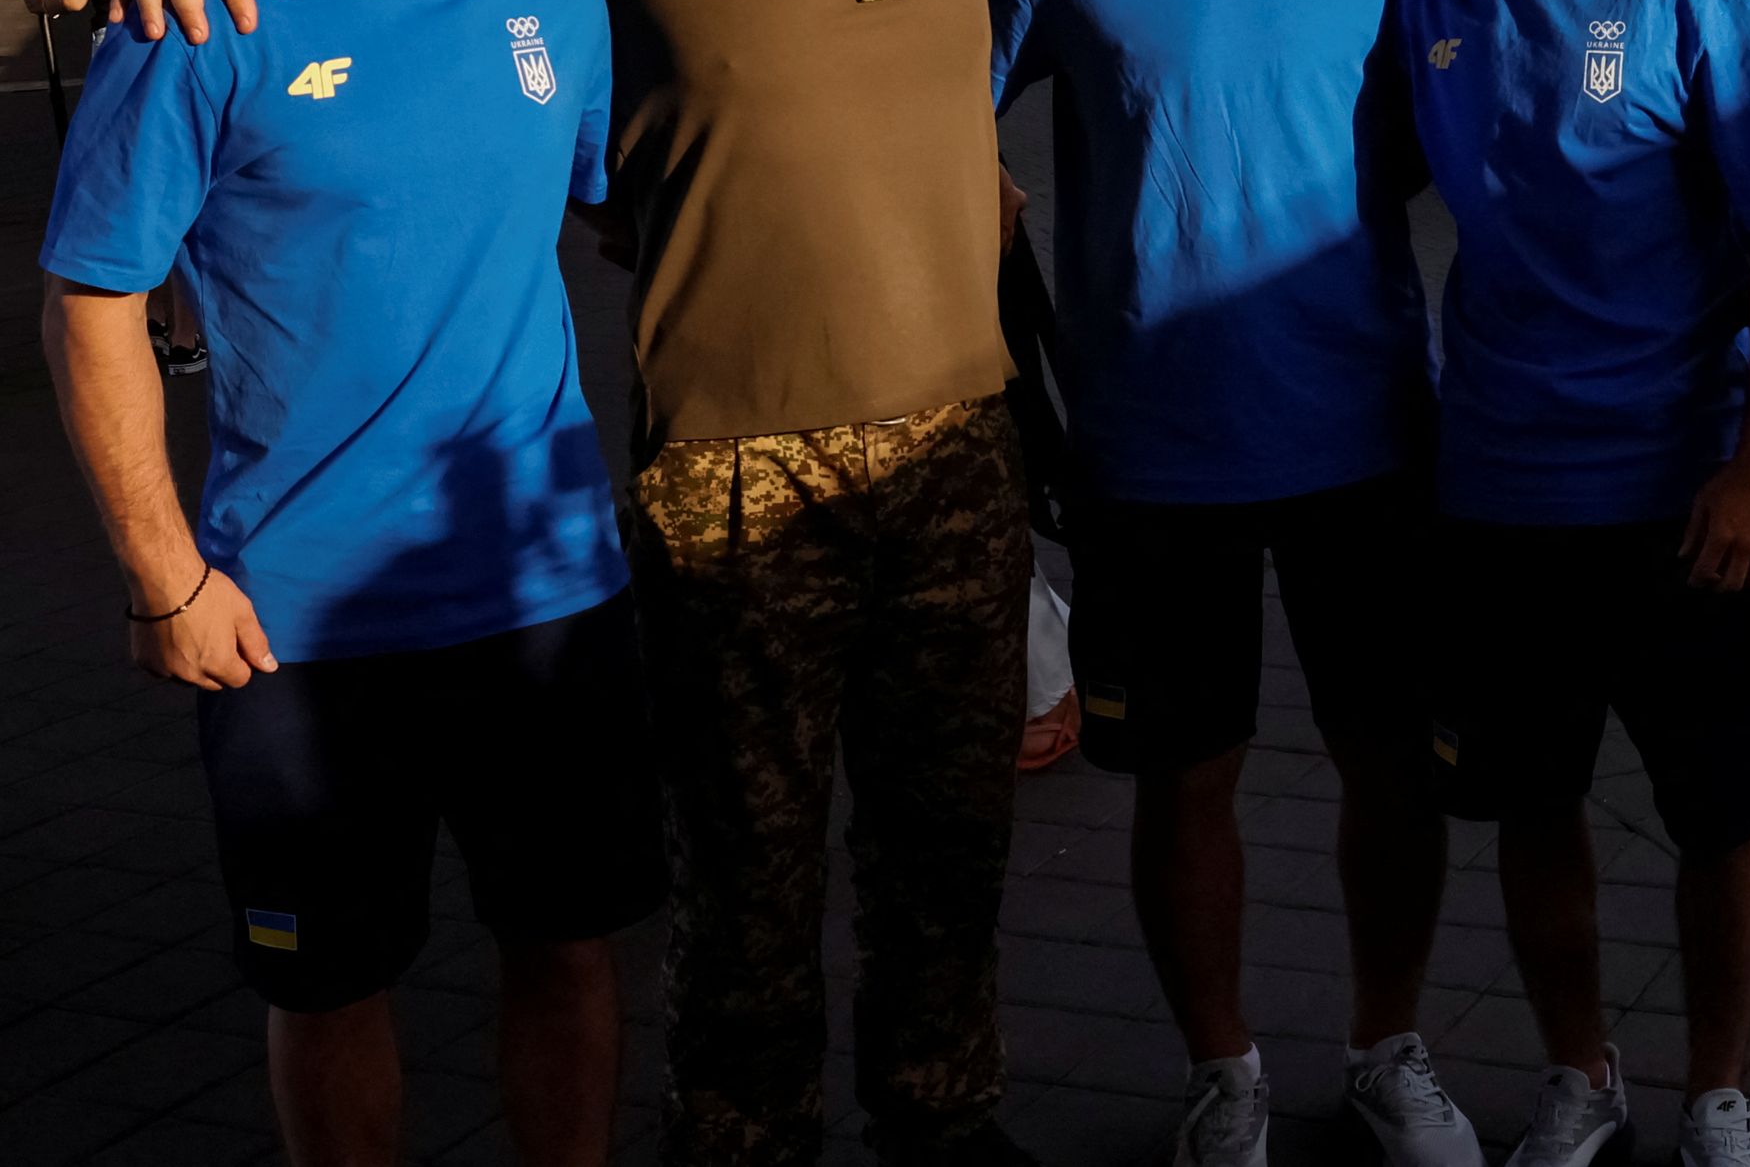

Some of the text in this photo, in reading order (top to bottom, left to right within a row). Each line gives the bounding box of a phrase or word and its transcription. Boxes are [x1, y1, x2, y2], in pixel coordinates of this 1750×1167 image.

[510, 37, 545, 49] UKRAINE
[1586, 41, 1625, 50] UKRAINE
[1426, 37, 1464, 71] 4F
[287, 56, 353, 101] 4F
[1716, 1100, 1737, 1112] 4F
